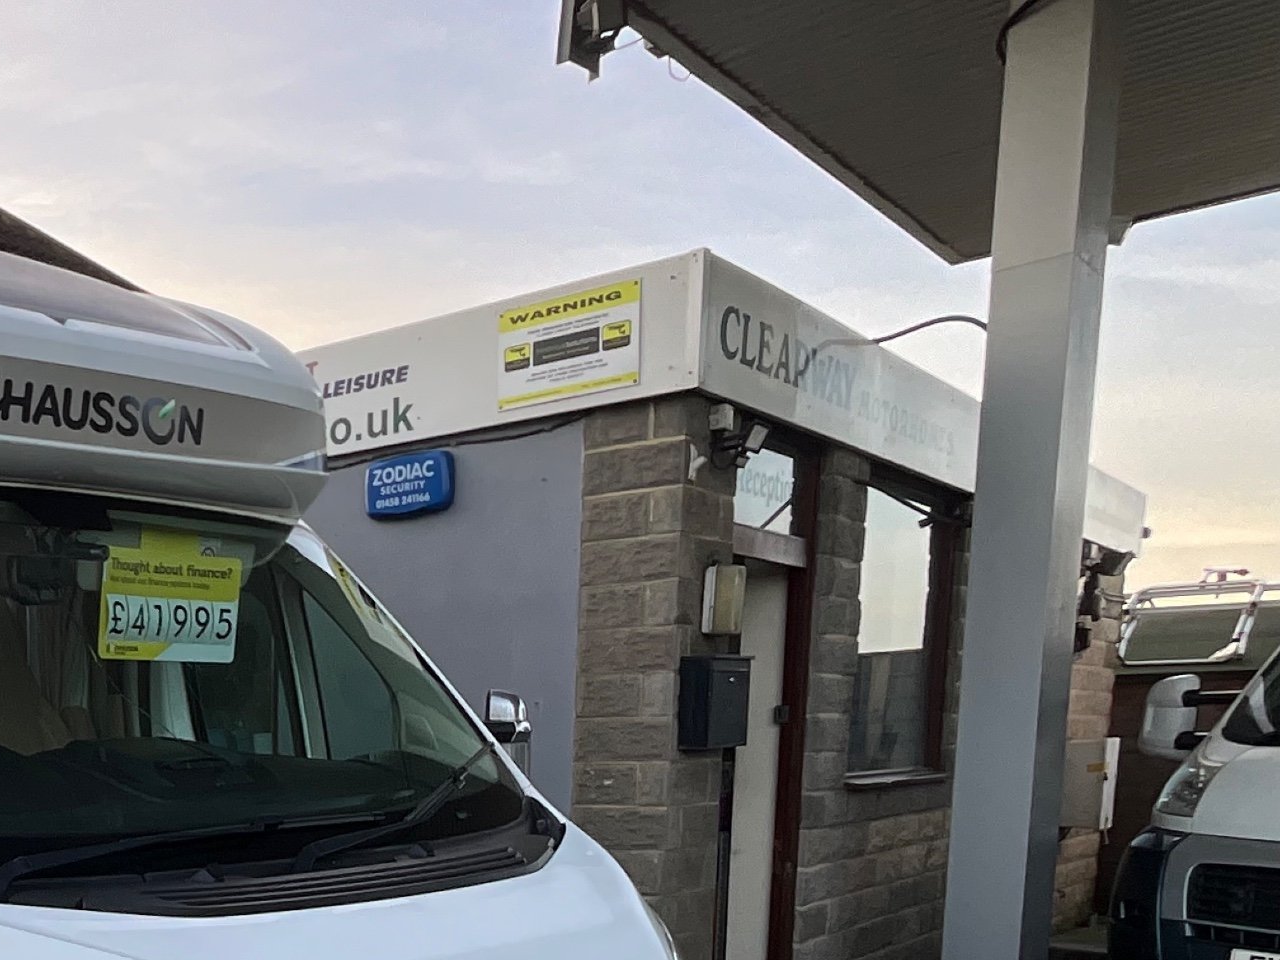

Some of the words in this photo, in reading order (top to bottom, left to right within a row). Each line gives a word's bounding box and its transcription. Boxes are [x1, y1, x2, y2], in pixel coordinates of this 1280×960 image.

[509, 290, 623, 325] WARNING
[322, 364, 410, 399] LEISURE
[372, 460, 435, 487] ZODIAC
[380, 480, 426, 496] SECURITY
[375, 496, 400, 510] 01458
[111, 557, 151, 576] Thought
[153, 562, 184, 577] about
[186, 565, 234, 580] finance?
[108, 600, 233, 640] £41995
